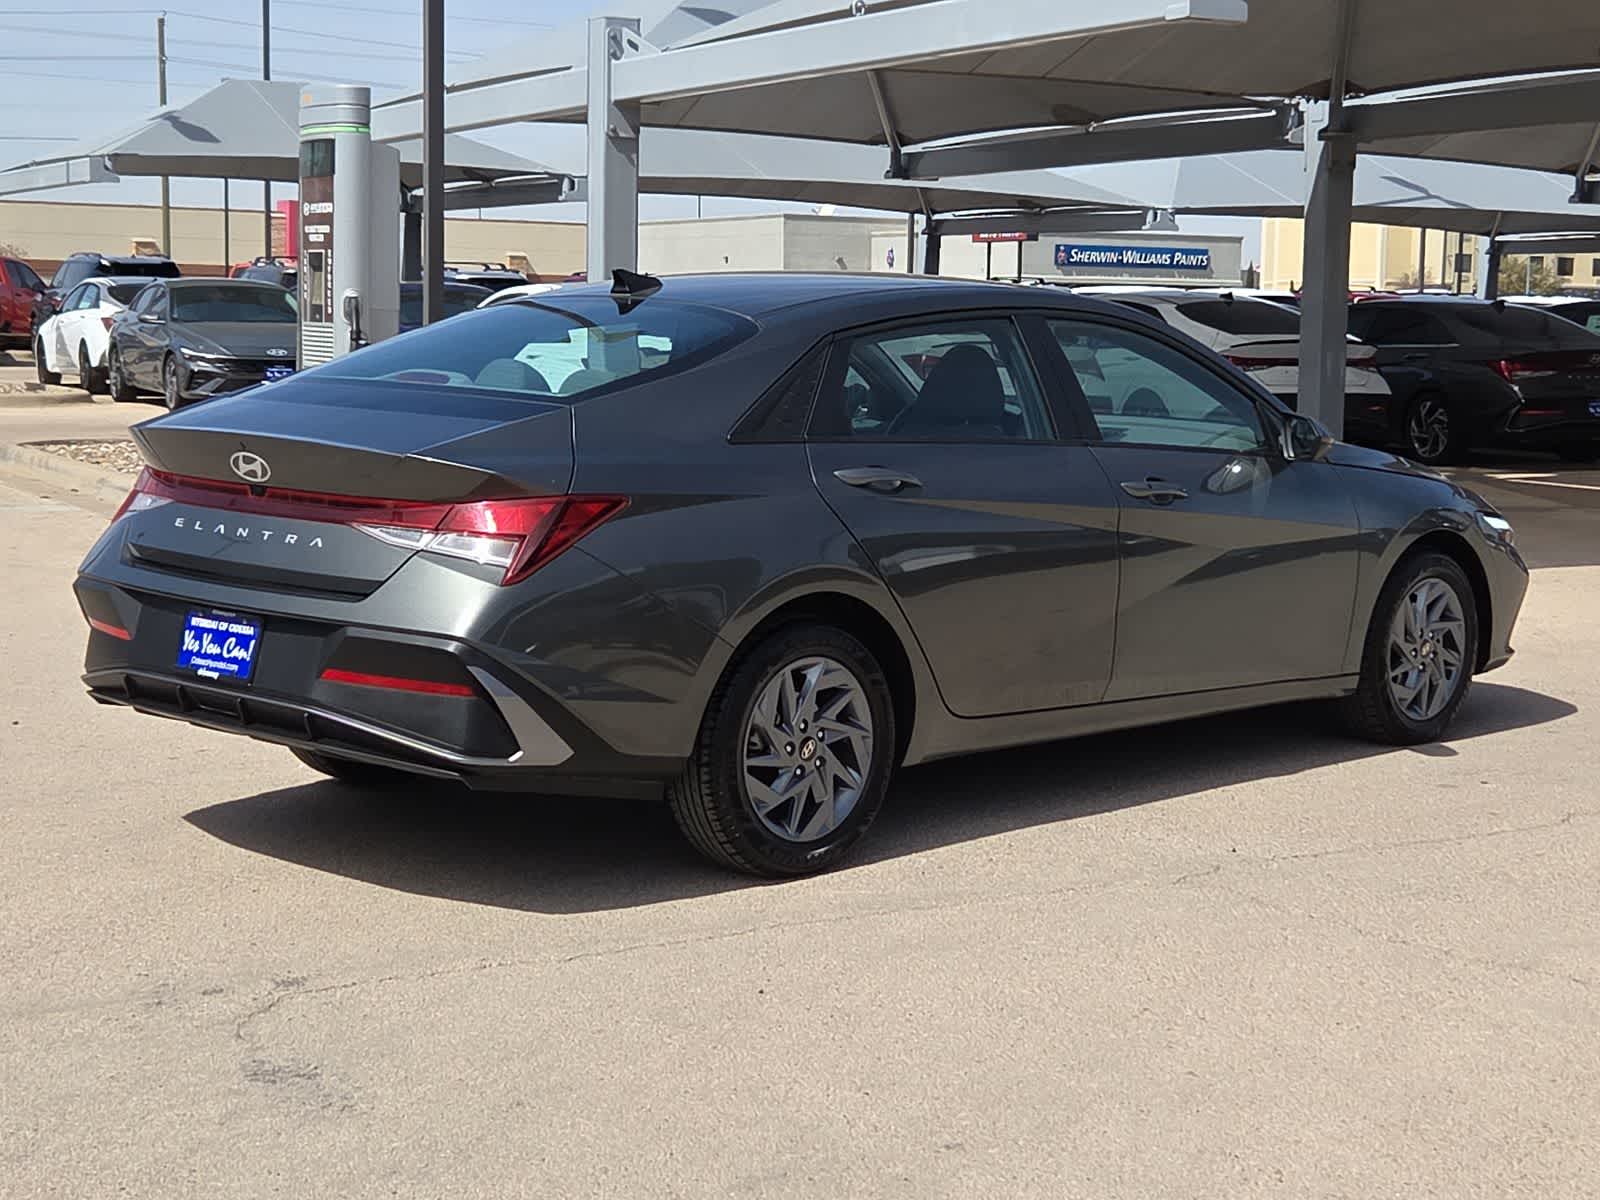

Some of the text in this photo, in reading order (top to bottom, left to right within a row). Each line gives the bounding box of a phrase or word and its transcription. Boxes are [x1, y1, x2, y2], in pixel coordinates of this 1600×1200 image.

[1069, 249, 1209, 266] SHERWIN-WILLIAMS PAINTS
[174, 517, 323, 548] ELANTRA
[183, 630, 256, 662] Yes You Can!
